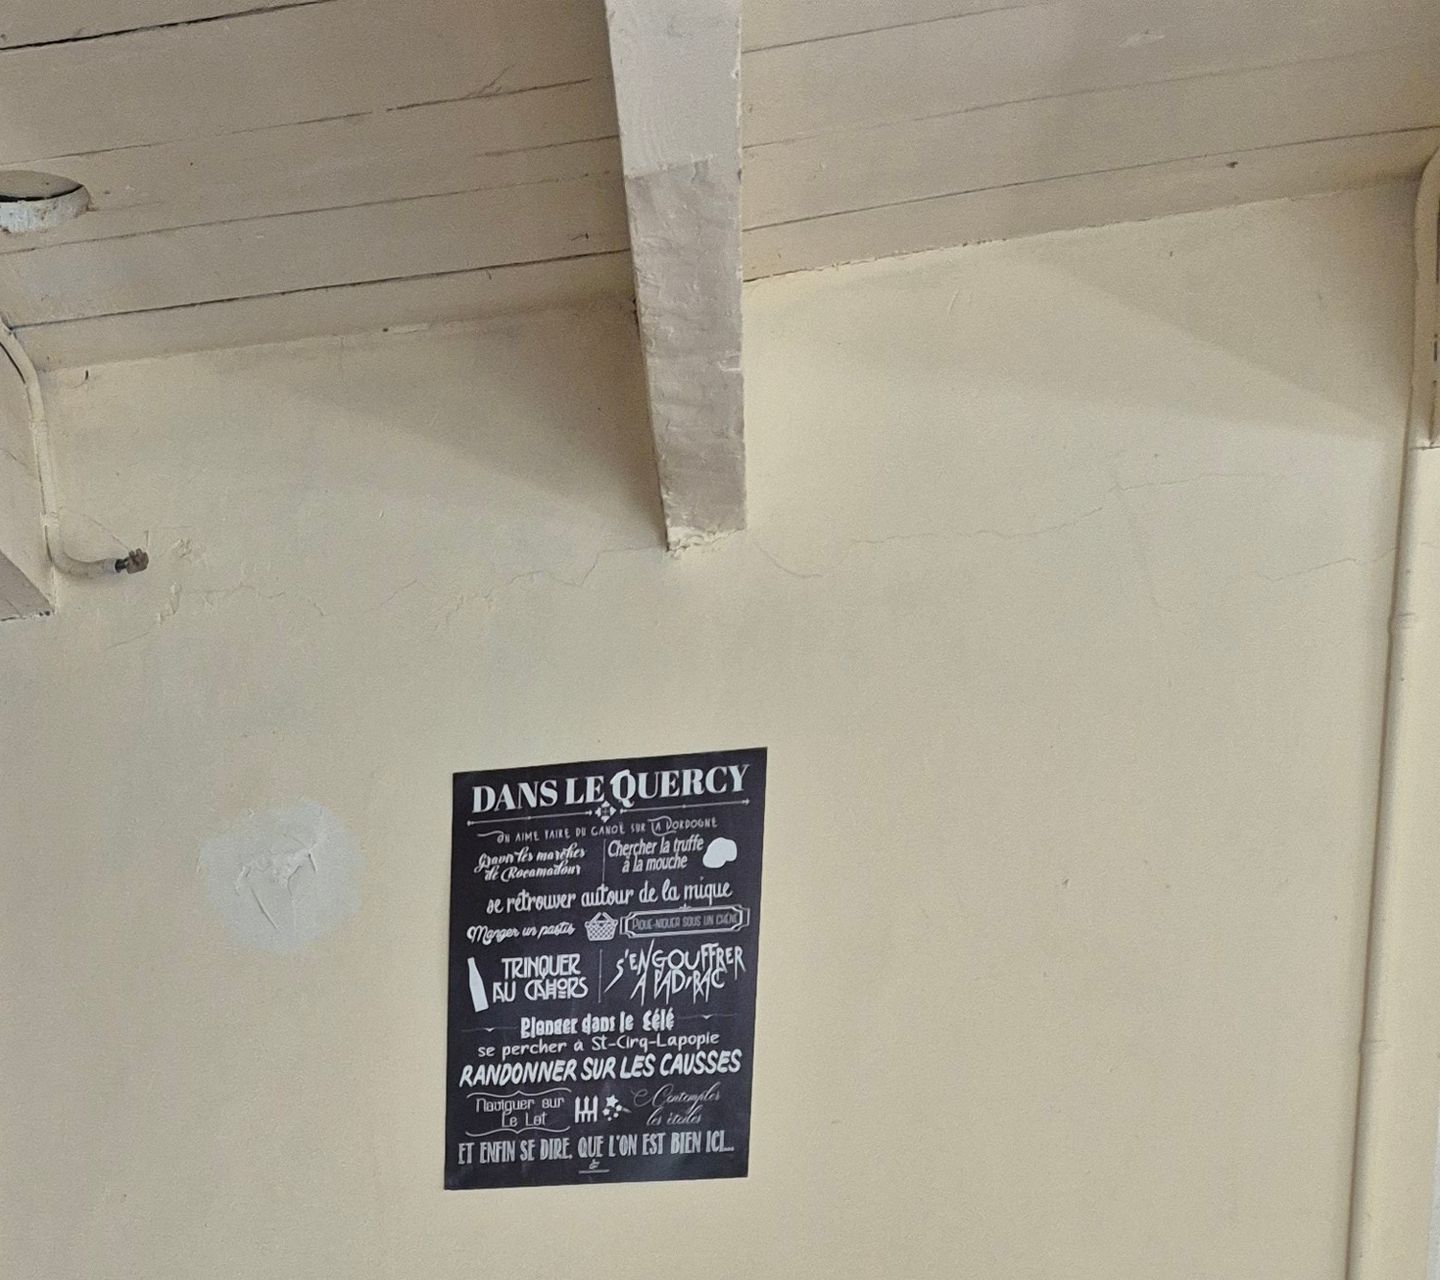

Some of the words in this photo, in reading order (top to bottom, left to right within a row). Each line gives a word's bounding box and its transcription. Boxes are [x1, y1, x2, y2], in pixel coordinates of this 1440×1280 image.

[472, 779, 558, 813] DANS
[565, 776, 604, 805] LE
[610, 764, 750, 808] QUERCY
[515, 831, 540, 842] AIME
[544, 828, 570, 839] FAIRE
[576, 826, 586, 837] DU
[631, 822, 646, 834] SUR
[666, 817, 718, 831] DORDOGNE
[515, 846, 534, 863] les
[537, 842, 586, 862] marches
[608, 839, 657, 857] Chercher
[661, 837, 670, 854] la
[673, 834, 704, 852] truffe
[484, 864, 499, 881] de
[501, 860, 581, 882] Rocamadour
[622, 855, 630, 873] à
[633, 853, 643, 873] la
[646, 852, 688, 871] mouche
[486, 898, 504, 914] se
[506, 889, 577, 913] retrouver
[581, 883, 635, 907] autour
[639, 880, 659, 903] de
[661, 878, 681, 901] la
[683, 876, 733, 906] mique
[467, 925, 520, 945] Manger
[522, 926, 537, 937] un
[537, 921, 575, 940] pastis
[501, 953, 581, 980] TRINQUER
[493, 981, 516, 1003] AU
[524, 977, 589, 1000] CAHORS
[582, 1013, 616, 1034] dans
[620, 1011, 634, 1033] le
[478, 1046, 496, 1057] se
[502, 1038, 567, 1061] percher
[574, 1039, 584, 1051] à
[592, 1031, 720, 1053] St-Cirq-Lapopie
[459, 1059, 577, 1088] RANDONNER
[581, 1055, 616, 1081] SUR
[620, 1053, 656, 1079] LES
[660, 1048, 742, 1076] CAUSSES
[542, 1097, 564, 1109] sur
[525, 1111, 548, 1126] Lot
[459, 1142, 475, 1164] ET
[480, 1140, 516, 1164] ENFIN
[520, 1139, 535, 1161] SE
[578, 1135, 604, 1158] QUE
[609, 1134, 637, 1157] L'ON
[642, 1132, 666, 1155] EST
[671, 1130, 701, 1153] BIEN
